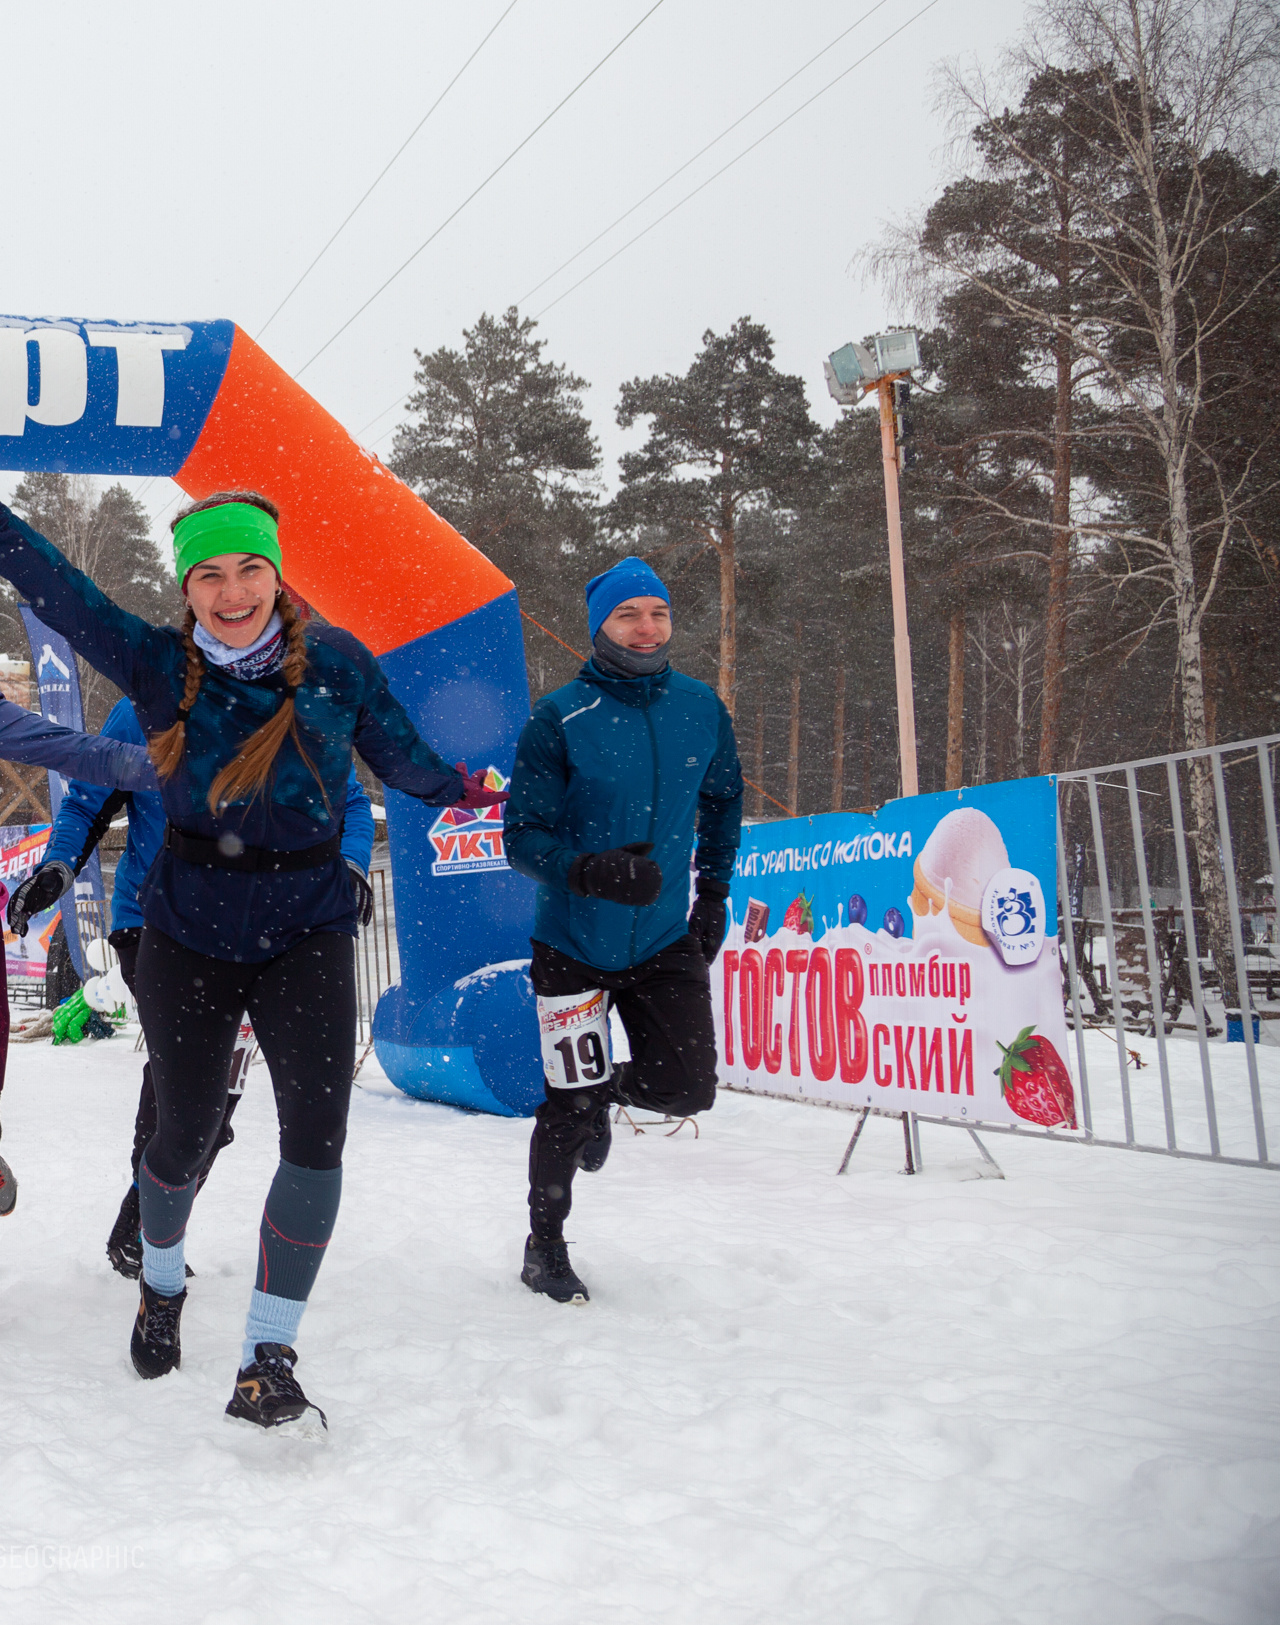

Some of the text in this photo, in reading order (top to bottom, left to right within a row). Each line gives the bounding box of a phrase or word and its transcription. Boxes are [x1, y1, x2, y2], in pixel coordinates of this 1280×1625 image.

[744, 904, 761, 943] ОСТОВ
[869, 955, 971, 1006] пломбир
[723, 947, 868, 1083] ГОСТОВ
[554, 1031, 606, 1083] 19
